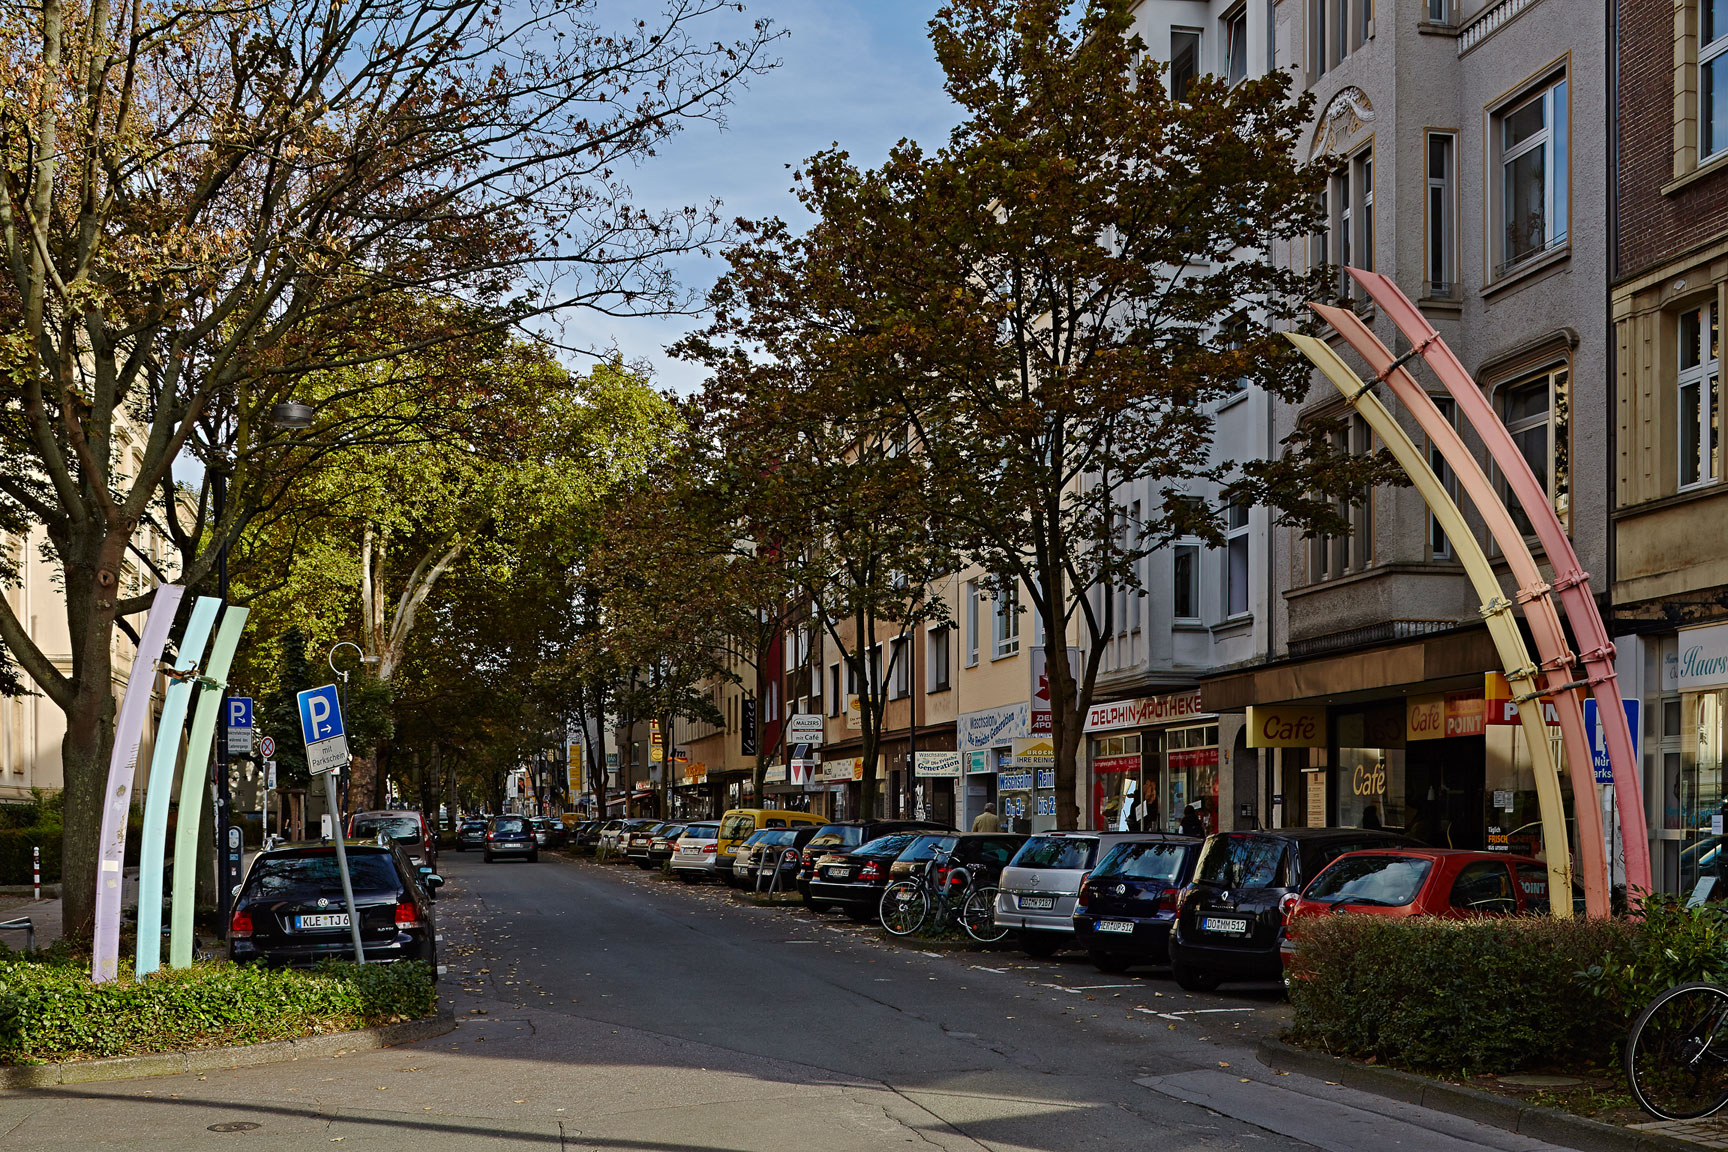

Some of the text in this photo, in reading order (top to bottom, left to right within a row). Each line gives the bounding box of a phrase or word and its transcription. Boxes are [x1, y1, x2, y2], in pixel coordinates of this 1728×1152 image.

[230, 701, 246, 726] P
[308, 695, 331, 740] P
[1091, 695, 1200, 726] DELPHIN-APOTHEKE
[1411, 704, 1440, 732] Café
[1263, 715, 1316, 740] Café
[1447, 715, 1482, 734] POINT
[312, 752, 346, 767] Parkschein
[322, 745, 333, 755] mit
[917, 760, 959, 771] Generation
[1594, 756, 1610, 767] Nur
[1353, 763, 1386, 796] Café
[1594, 767, 1613, 778] arks
[1048, 796, 1057, 815] 2
[303, 916, 321, 927] KLE
[329, 915, 341, 926] TJ
[1231, 920, 1246, 931] 512
